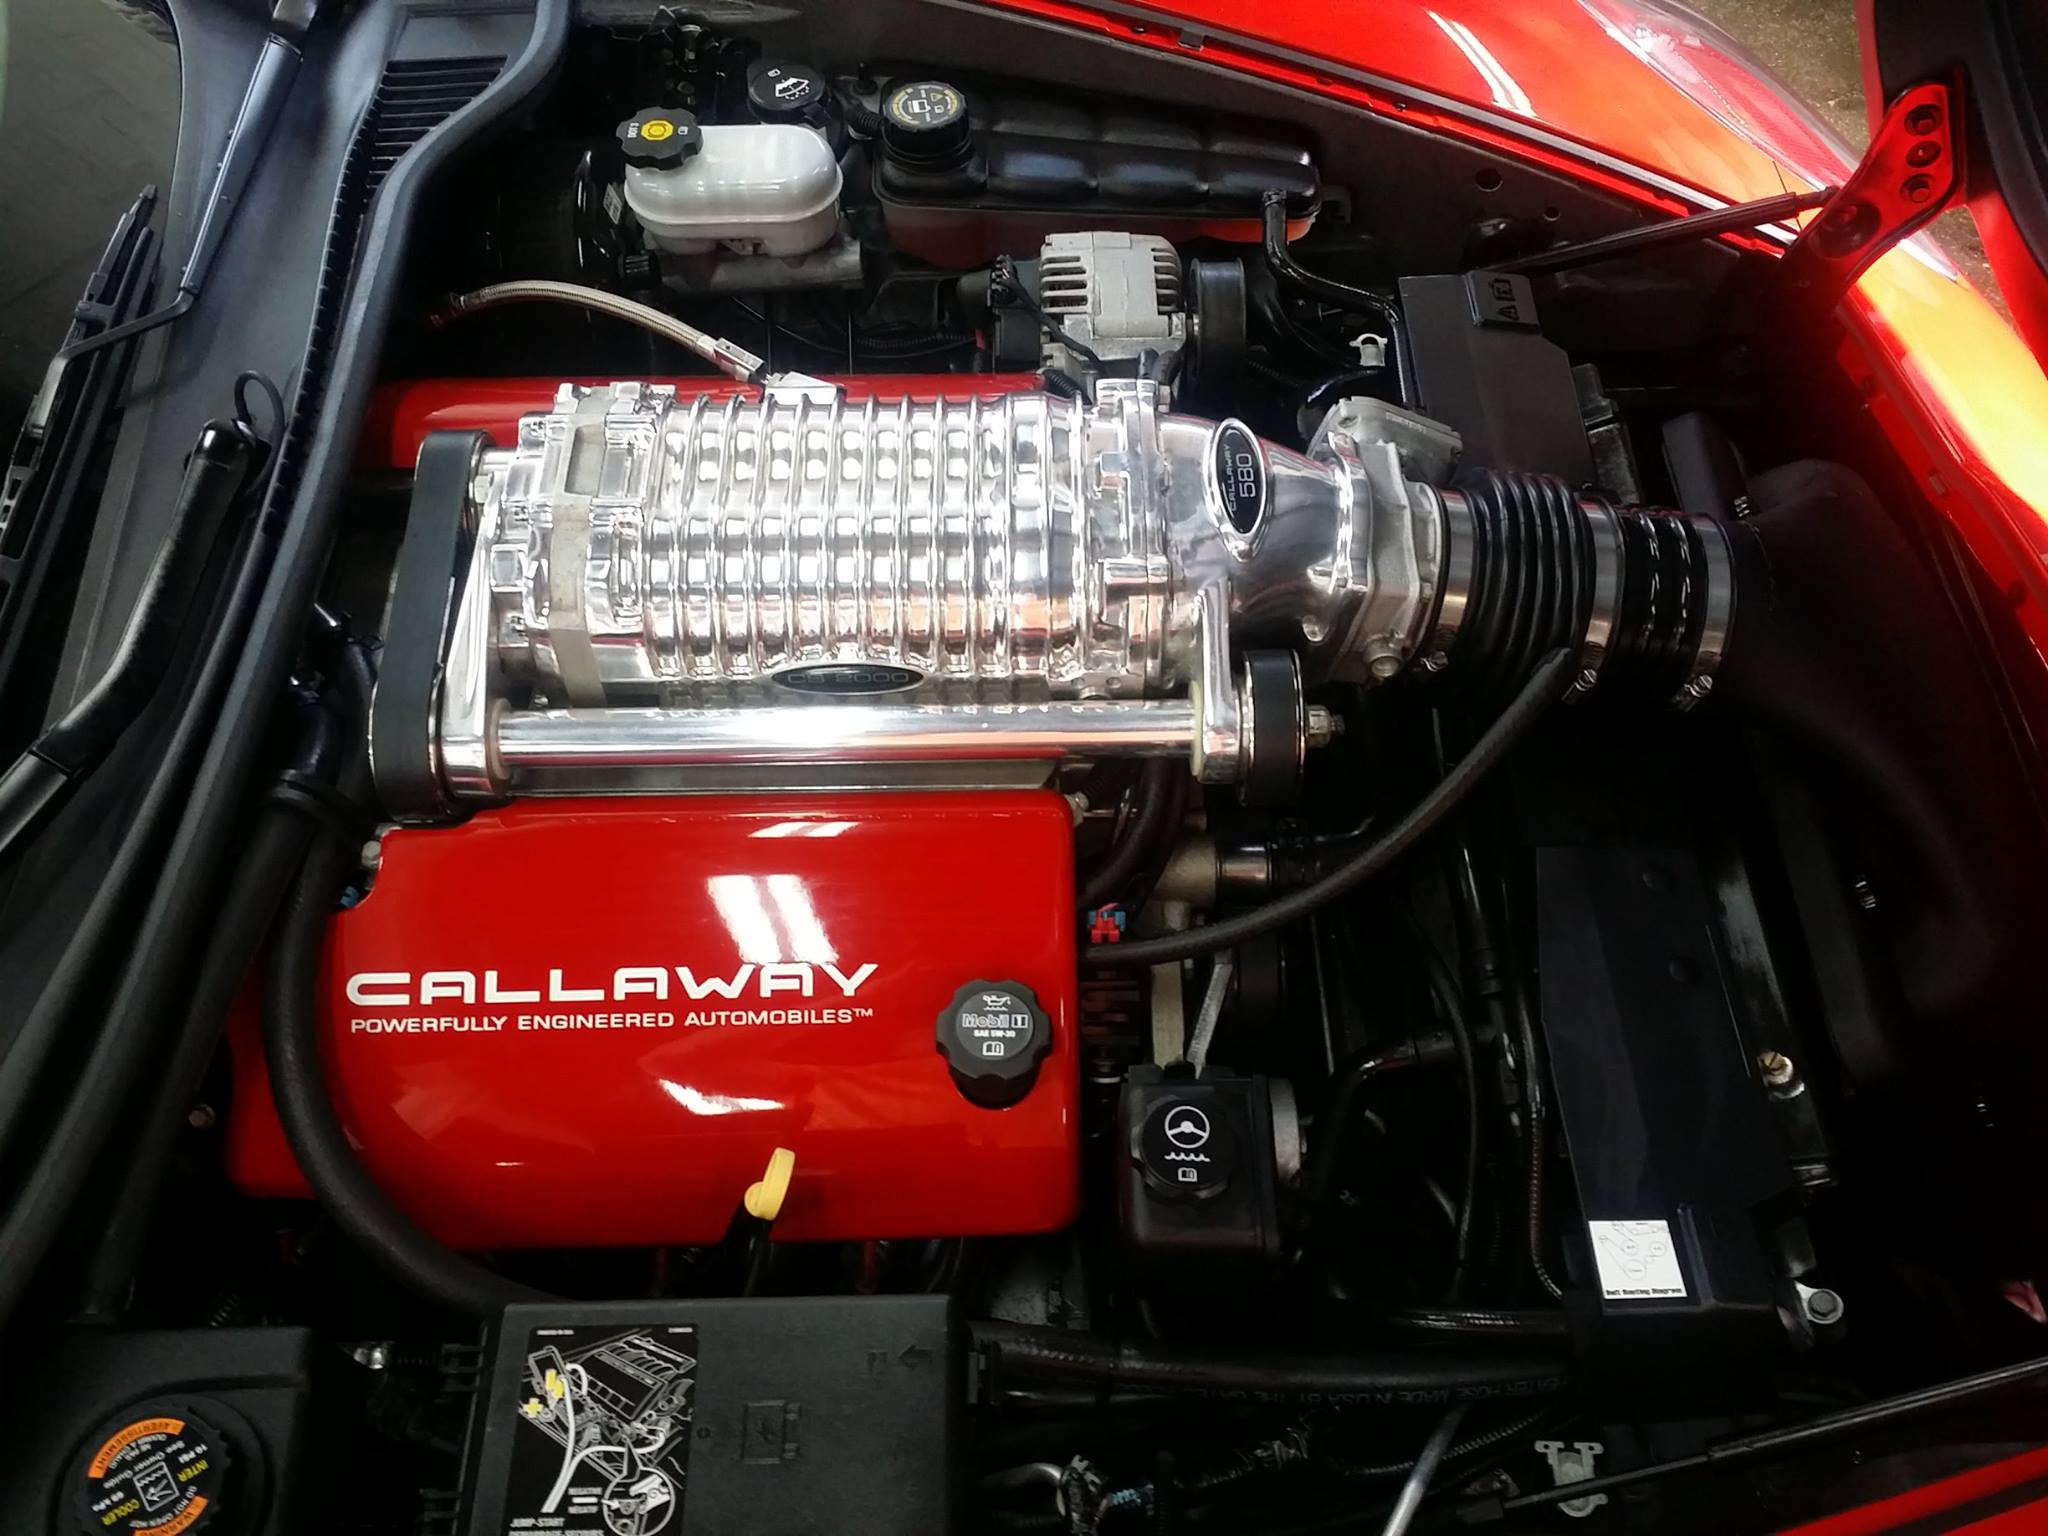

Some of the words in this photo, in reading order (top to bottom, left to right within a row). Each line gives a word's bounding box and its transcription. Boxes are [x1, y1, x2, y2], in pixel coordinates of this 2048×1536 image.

[1223, 444, 1239, 512] CALLAWAY
[1235, 453, 1256, 498] 580
[346, 963, 879, 1006] CALLAWAY
[350, 1015, 508, 1034] POWERFULLY
[517, 1012, 675, 1032] ENGINEERED
[961, 1013, 1011, 1029] Mobil
[132, 1451, 166, 1473] Owner
[176, 1458, 209, 1483] INTER
[102, 1469, 134, 1490] Guide
[101, 1498, 141, 1527] COOLER
